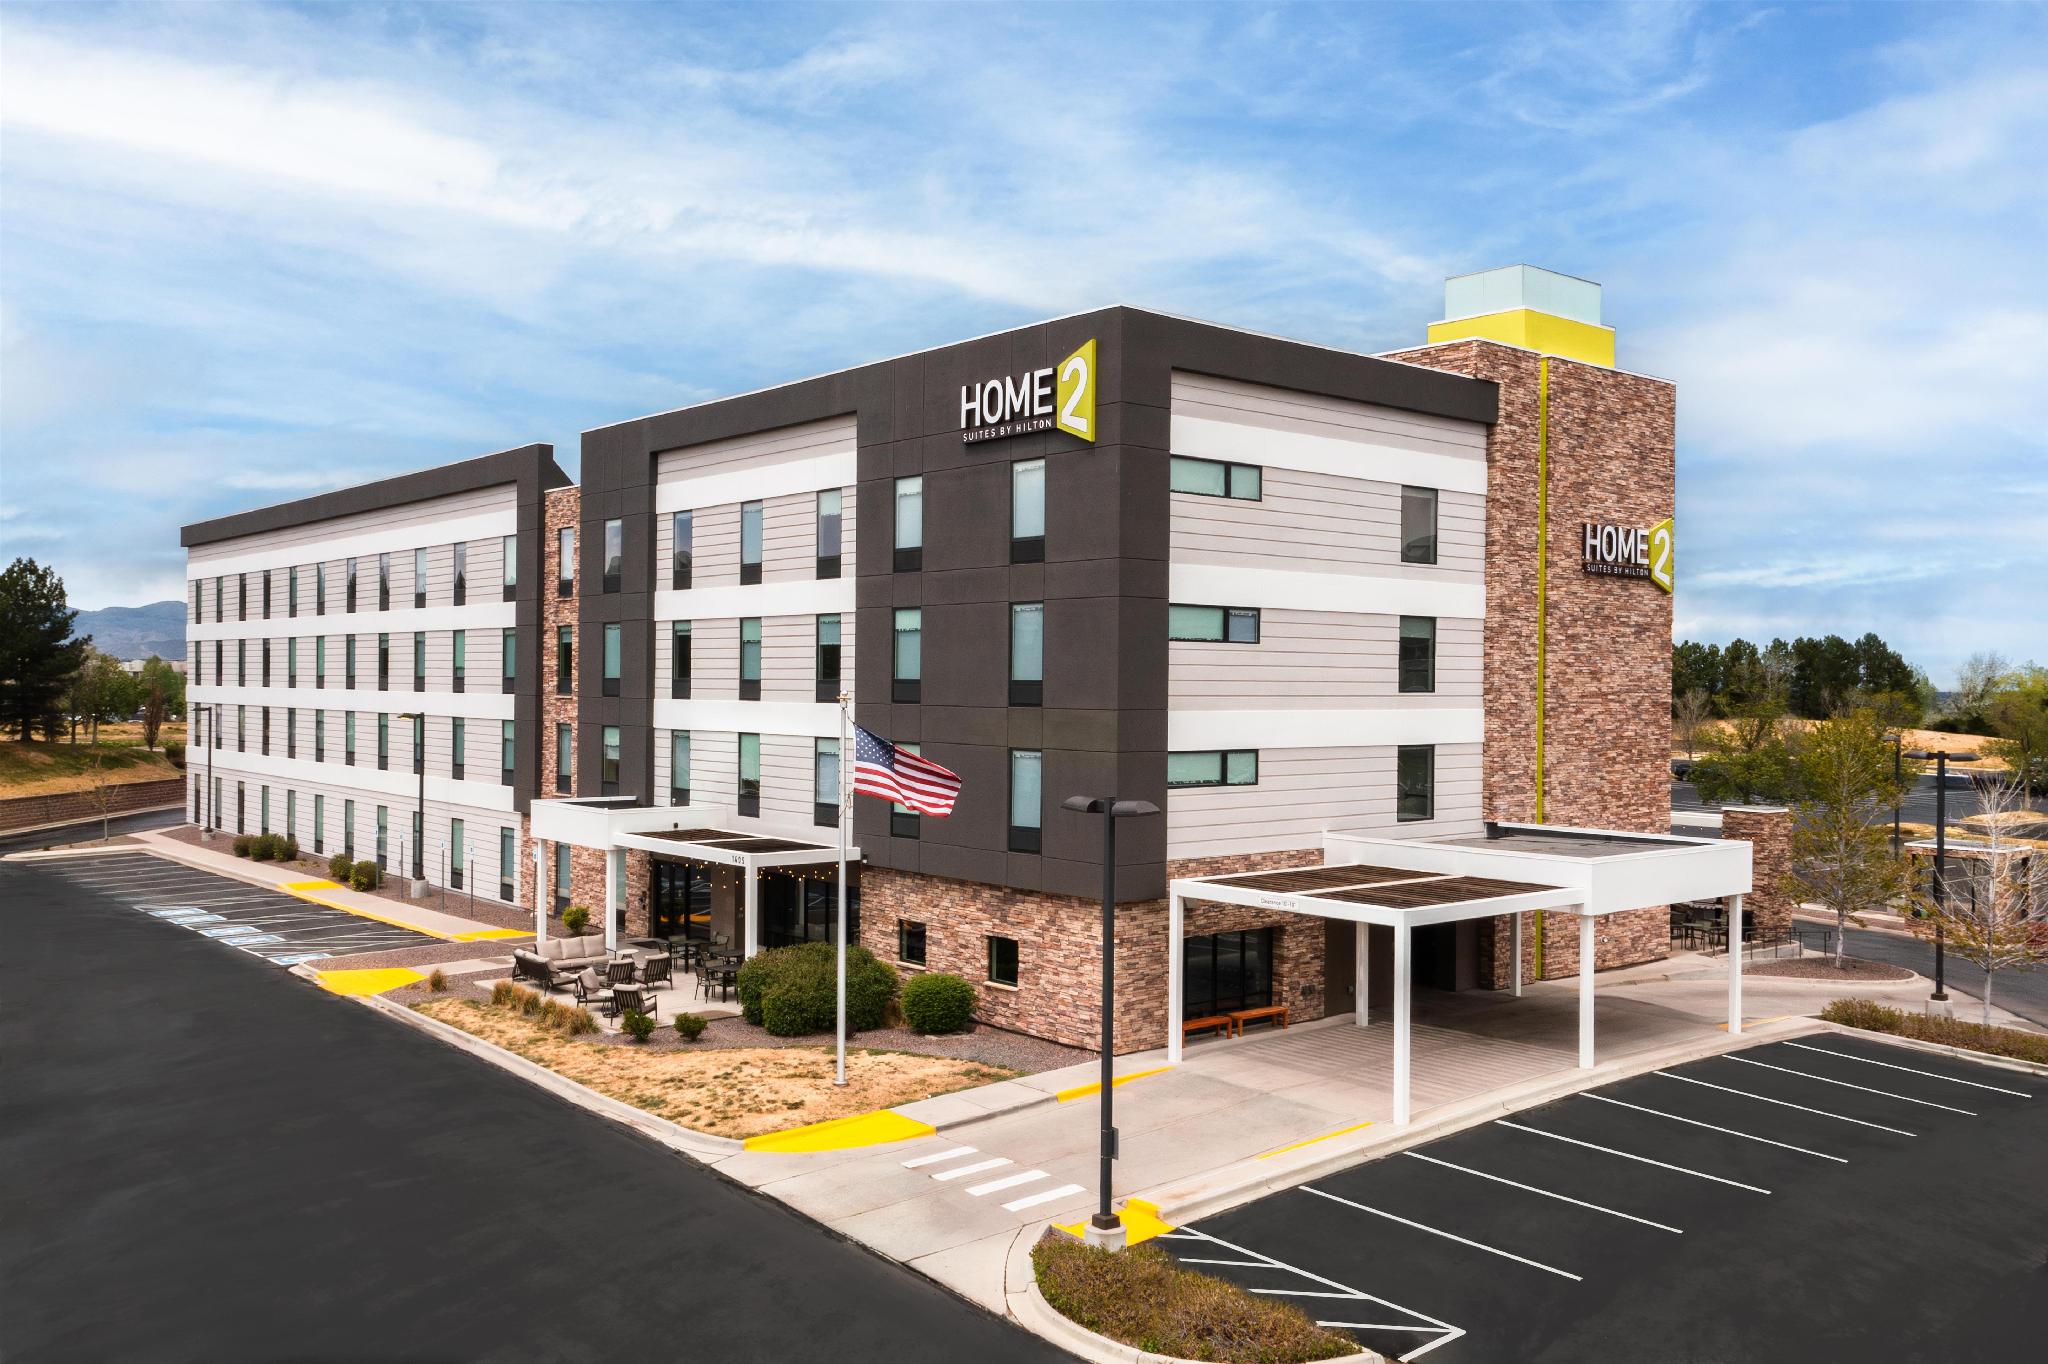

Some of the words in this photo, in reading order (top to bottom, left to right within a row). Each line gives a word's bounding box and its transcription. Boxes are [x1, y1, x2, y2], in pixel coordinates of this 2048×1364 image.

[960, 367, 1053, 429] HOME
[1061, 356, 1088, 433] 2
[962, 428, 996, 442] SUITES
[1000, 425, 1011, 436] BY
[1016, 418, 1052, 433] HILTON
[1585, 523, 1650, 565] HOME
[1654, 528, 1670, 586] 2
[1586, 563, 1611, 574] SUITES
[1614, 566, 1622, 574] BY
[1625, 567, 1649, 577] HILTON
